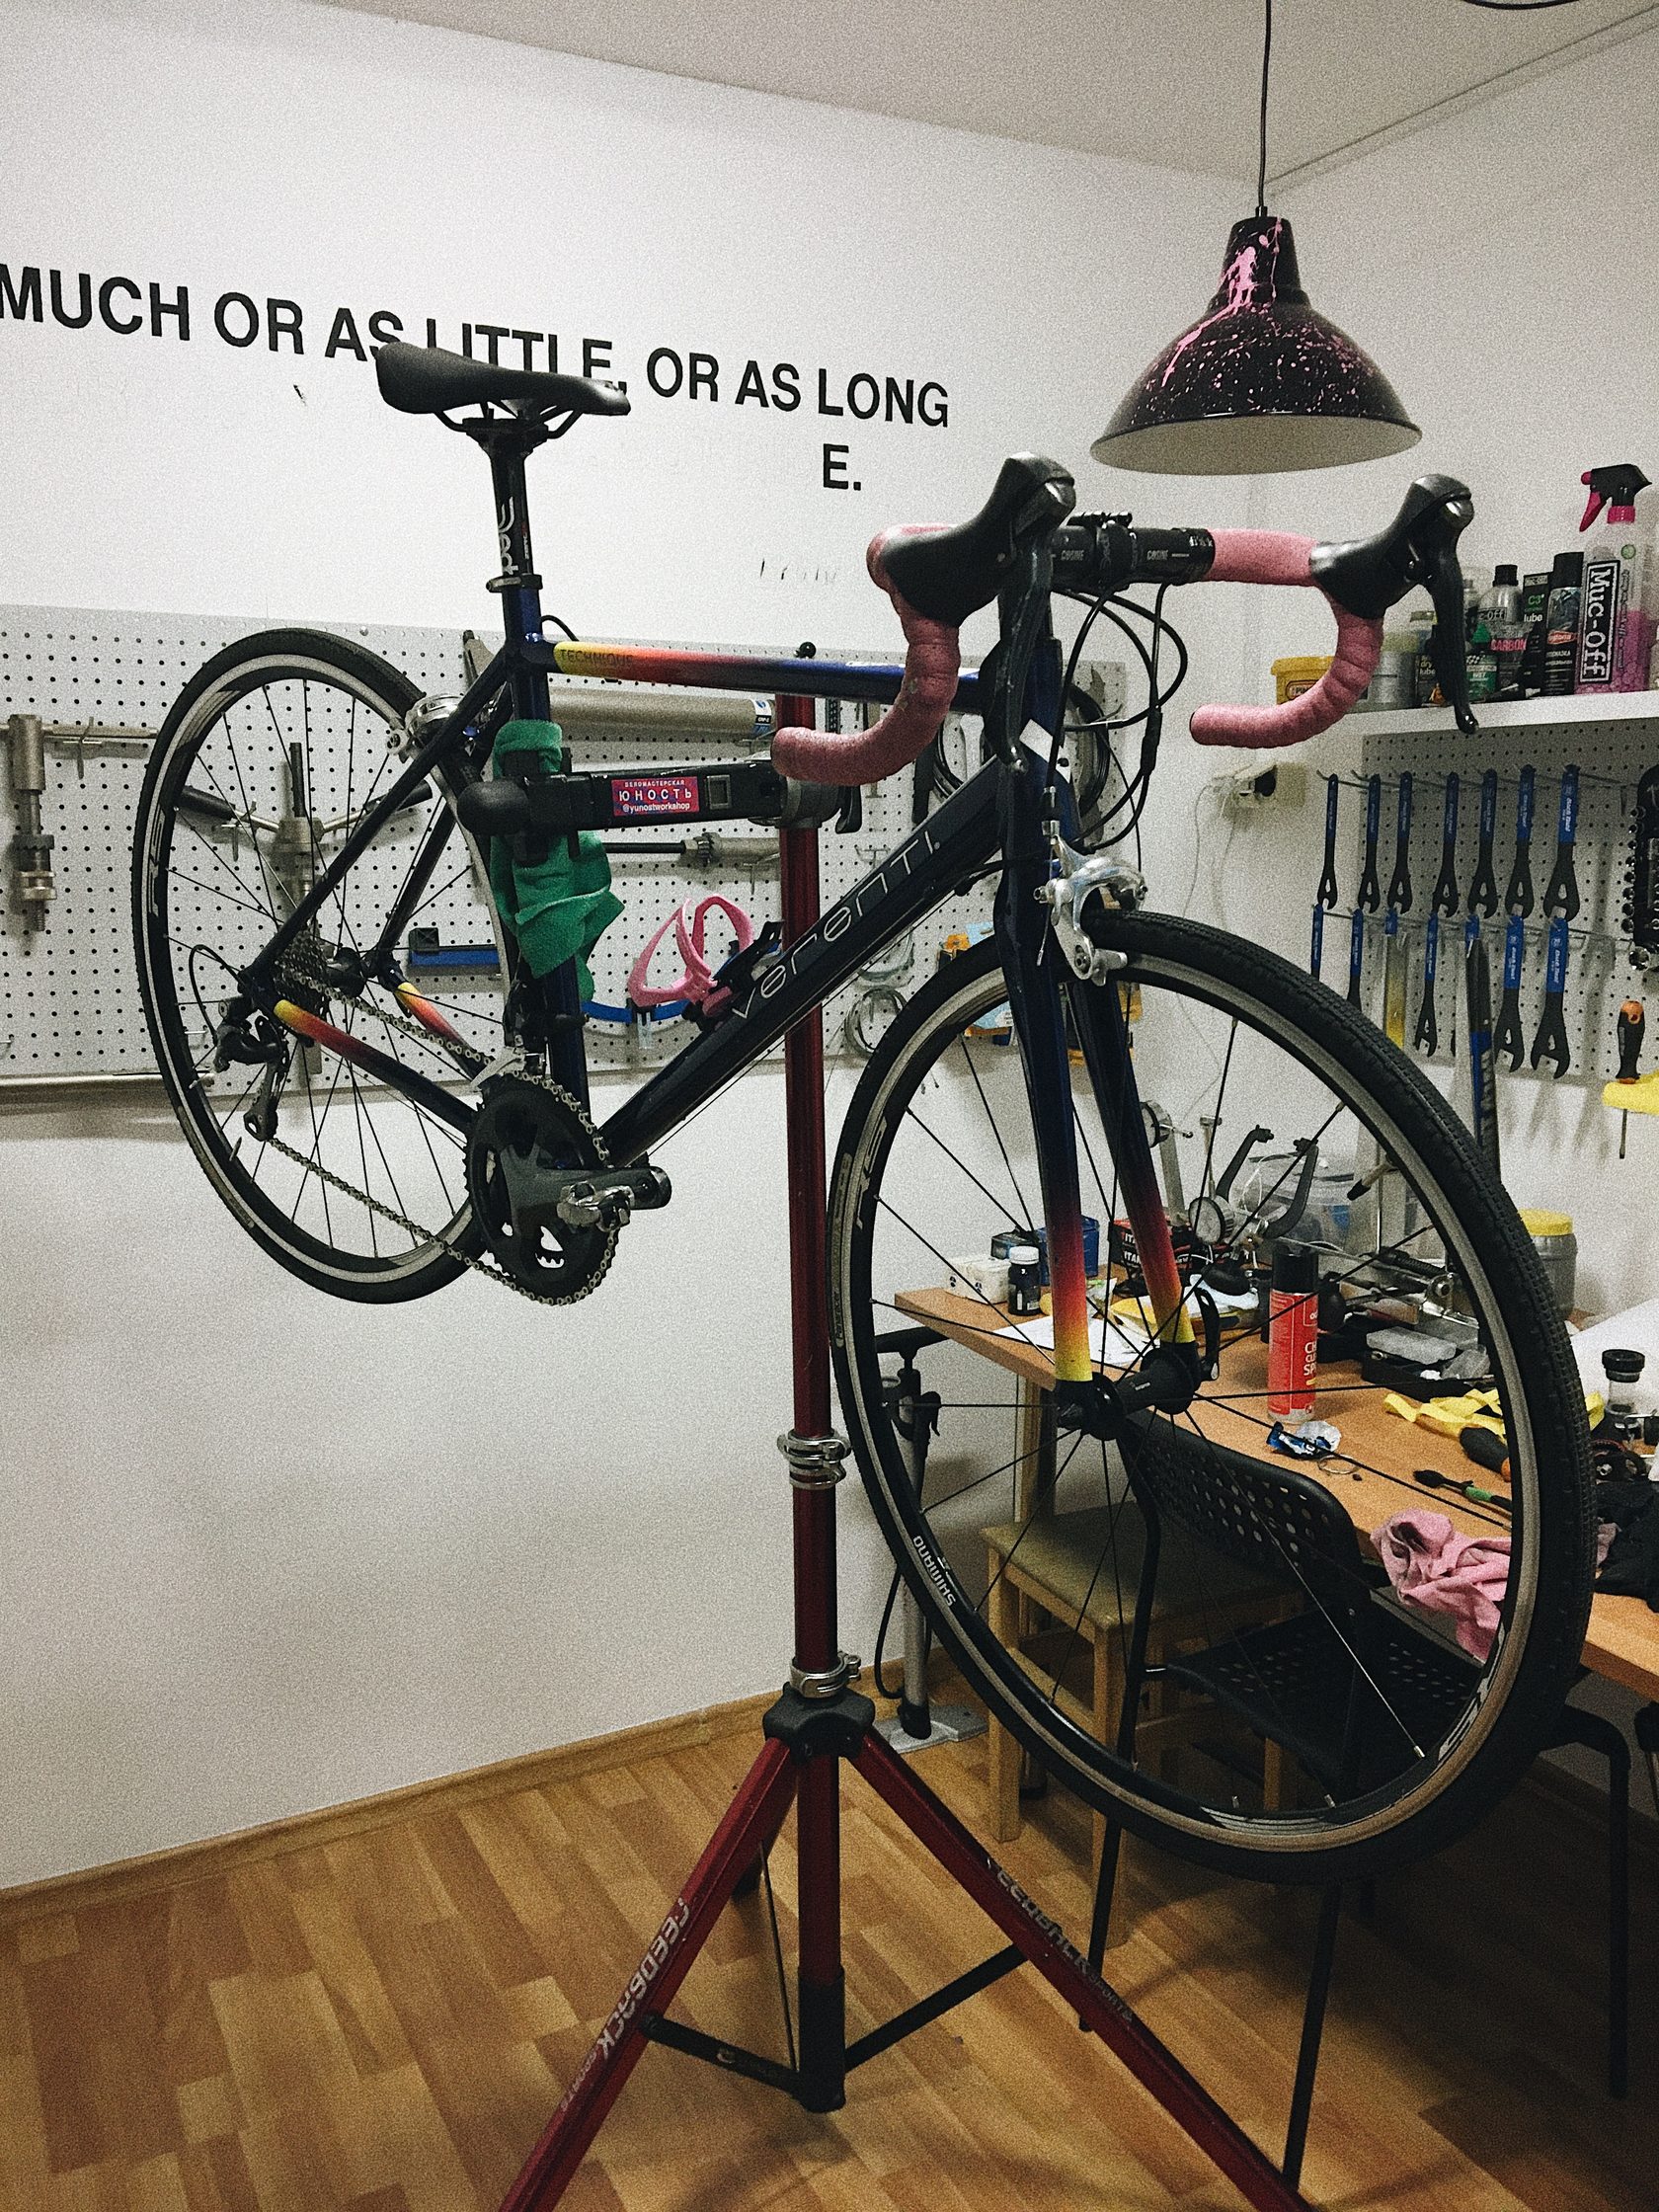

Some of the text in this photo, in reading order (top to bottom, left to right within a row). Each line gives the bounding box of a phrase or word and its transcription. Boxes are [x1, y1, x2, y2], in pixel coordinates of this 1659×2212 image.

[0, 264, 191, 341] MUCH
[214, 292, 304, 355] OR
[325, 308, 404, 362] AS
[647, 348, 719, 402] OR
[735, 359, 801, 412] AS
[819, 368, 948, 427] LONG
[823, 443, 861, 490] E.
[1523, 613, 1542, 623] lube
[1583, 568, 1612, 676] Muc-Off
[1491, 638, 1527, 651] CARBON
[619, 788, 692, 802] ЮНОСТЬ
[912, 1535, 956, 1607] SHIMANO
